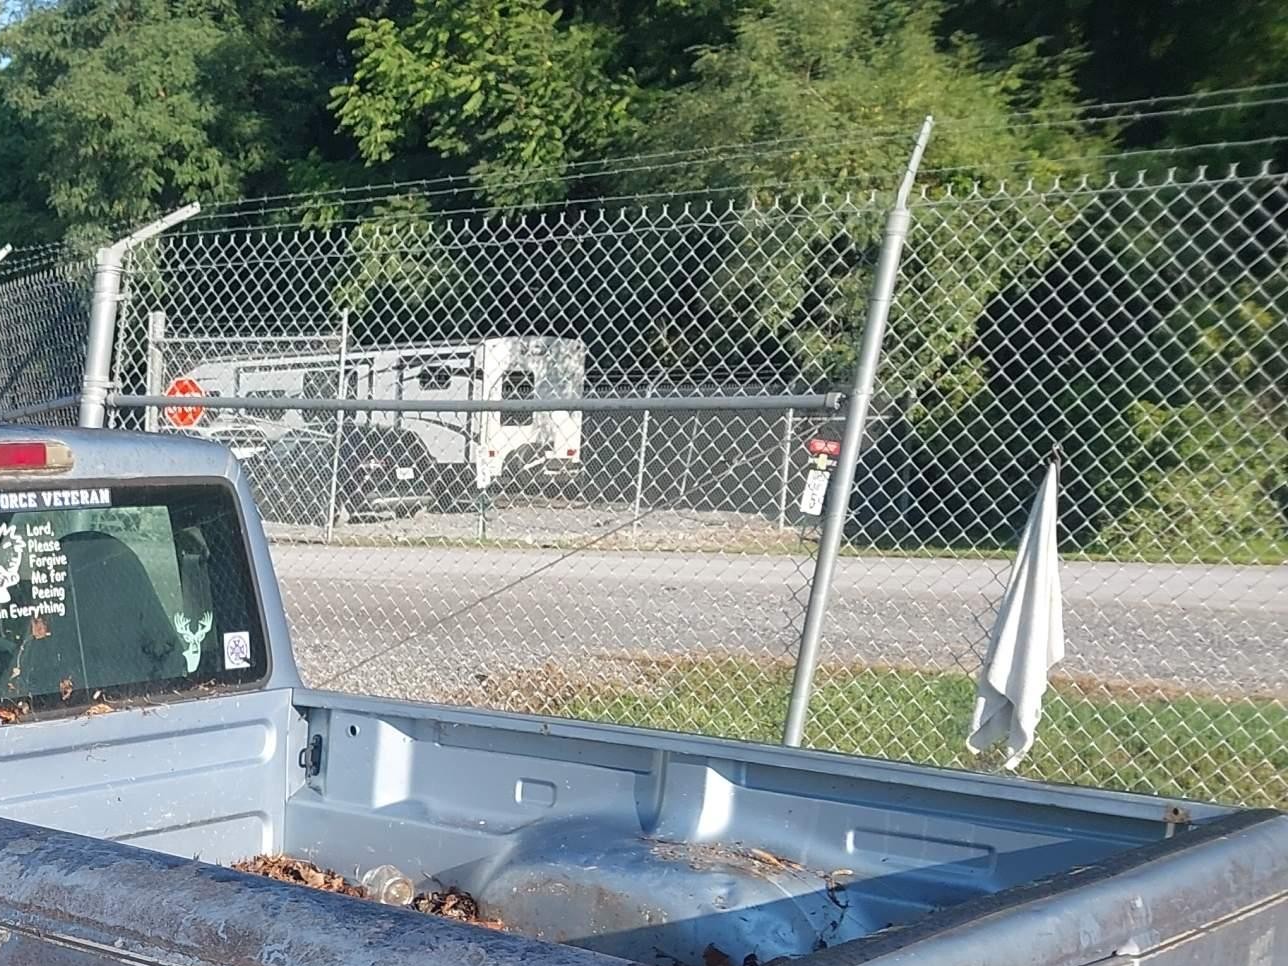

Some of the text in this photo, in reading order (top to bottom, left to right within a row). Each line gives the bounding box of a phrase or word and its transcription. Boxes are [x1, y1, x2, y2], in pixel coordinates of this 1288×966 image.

[41, 487, 110, 508] VETERAN
[26, 520, 55, 537] Lord,
[27, 538, 61, 553] Please
[28, 553, 68, 571] Forgive
[31, 568, 67, 585] Me for
[31, 584, 65, 601] Peeing
[10, 600, 66, 620] Everything
